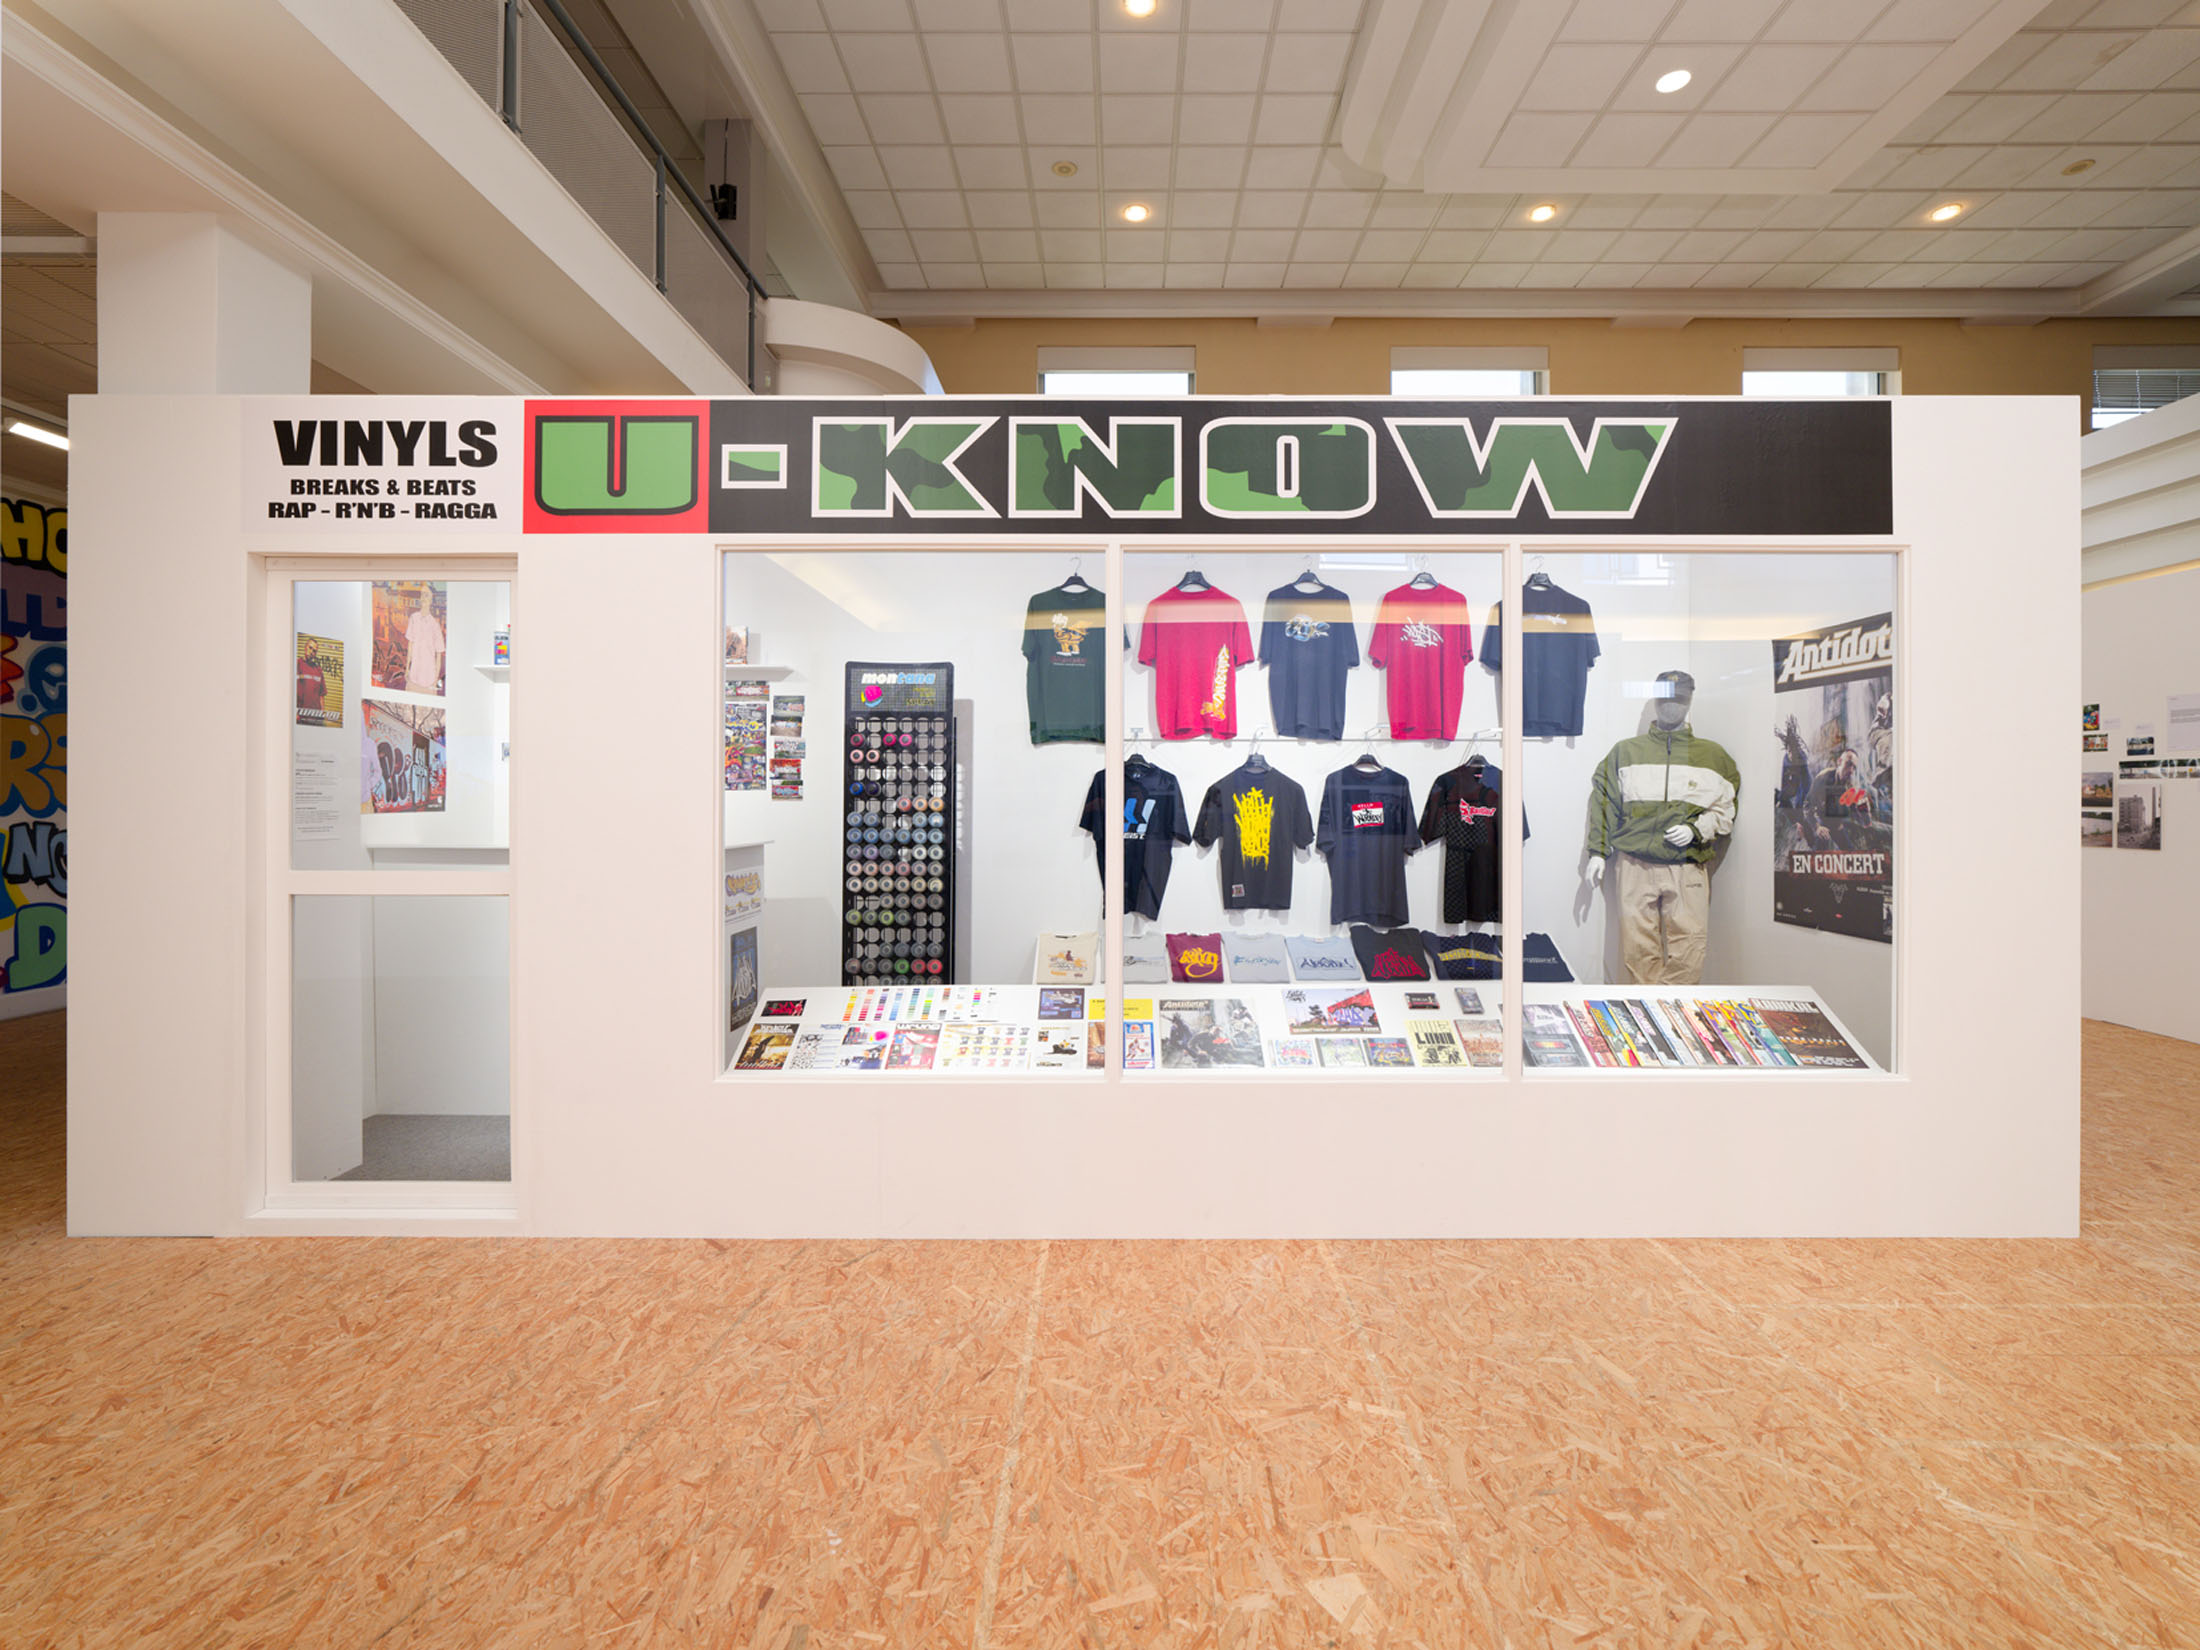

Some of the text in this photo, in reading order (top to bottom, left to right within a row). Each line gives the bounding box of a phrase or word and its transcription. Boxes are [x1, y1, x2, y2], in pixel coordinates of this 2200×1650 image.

[273, 420, 498, 467] VINYLS
[290, 479, 476, 496] BREAKS & BEATS
[268, 502, 317, 518] RAP
[335, 502, 396, 518] R'N'B
[415, 503, 498, 519] RAGGA
[861, 672, 936, 685] montana
[1793, 853, 1885, 875] EN CONCERT
